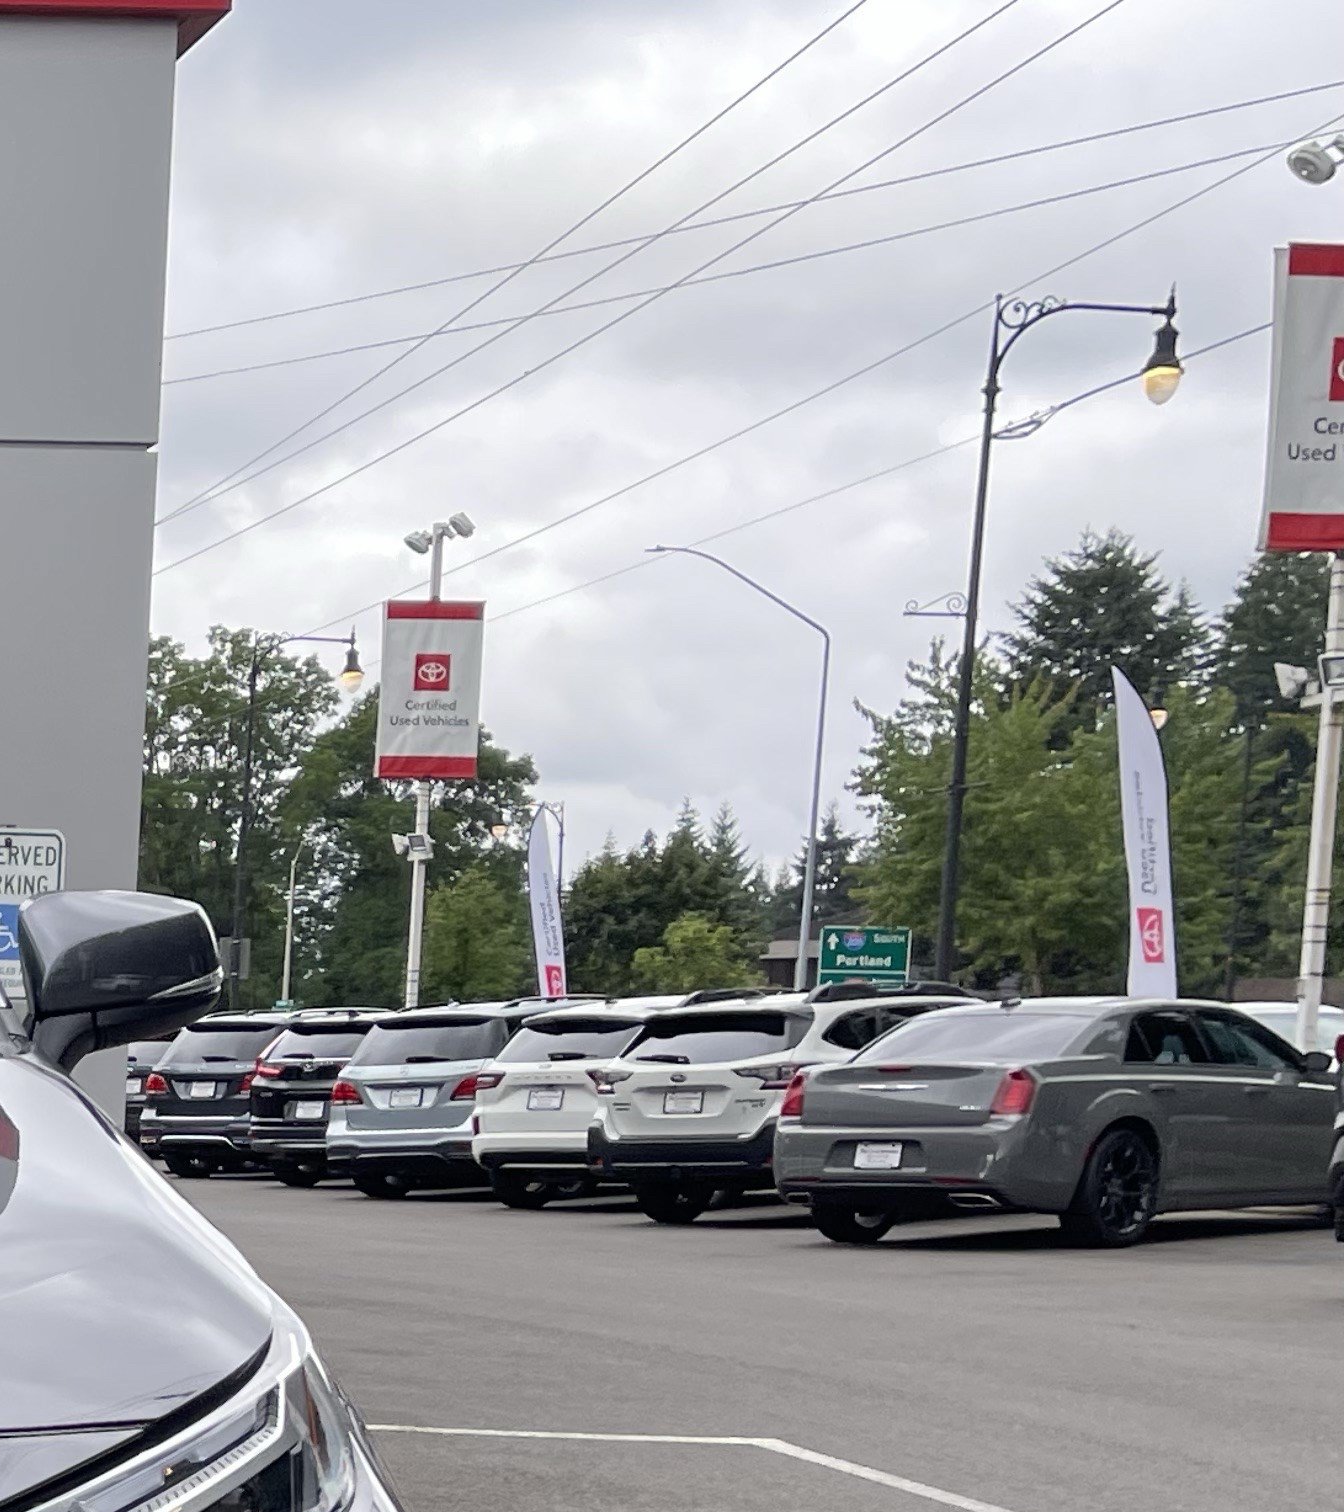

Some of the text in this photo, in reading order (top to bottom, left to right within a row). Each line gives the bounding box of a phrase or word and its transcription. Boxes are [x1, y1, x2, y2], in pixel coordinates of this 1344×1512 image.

[1288, 442, 1336, 461] Used
[405, 700, 457, 711] Certified
[390, 715, 469, 726] Used Vehicles
[836, 954, 892, 968] Portland
